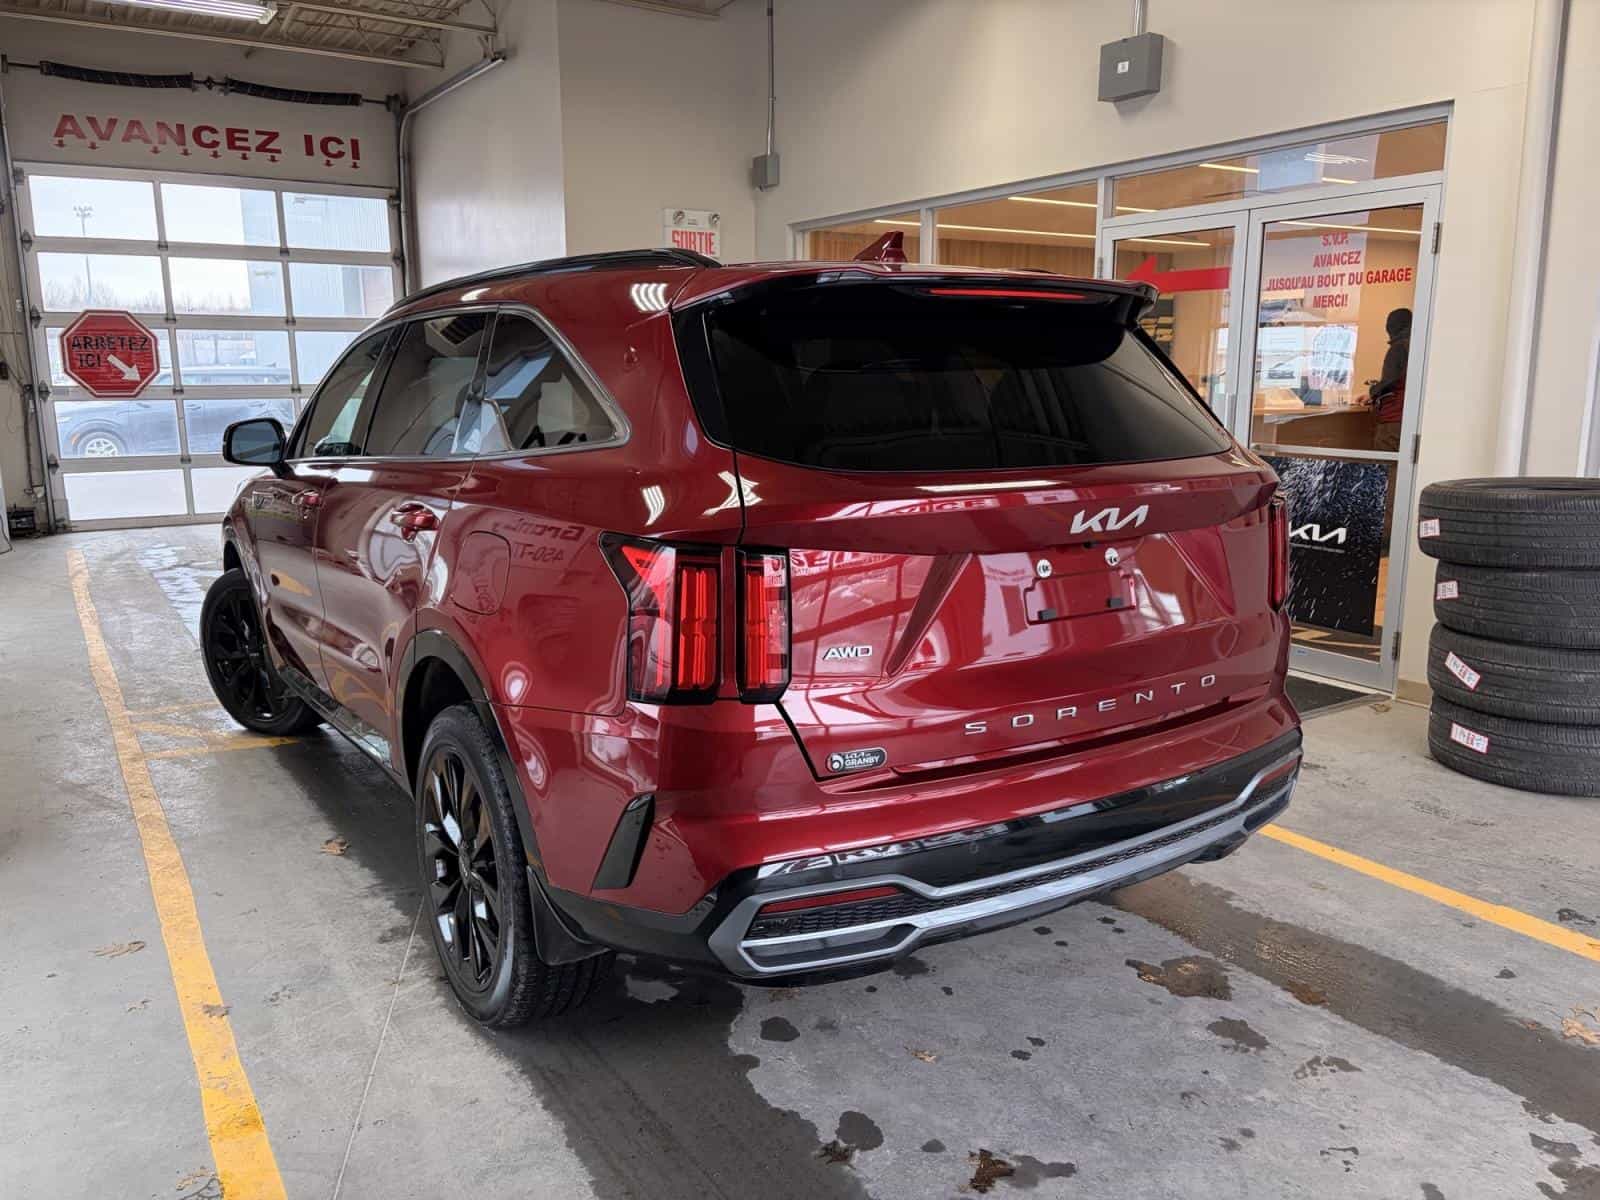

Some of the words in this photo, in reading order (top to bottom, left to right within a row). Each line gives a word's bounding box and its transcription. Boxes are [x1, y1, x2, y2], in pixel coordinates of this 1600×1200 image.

[53, 114, 282, 154] AVANCEZ
[303, 134, 360, 160] ICI
[671, 229, 716, 255] SORTIE
[1321, 233, 1349, 247] S.V.P.
[1313, 251, 1361, 268] AVANCEZ
[1266, 275, 1314, 291] JUSQU'AU
[1317, 273, 1346, 288] BOUT
[1348, 270, 1363, 285] DU
[1365, 268, 1412, 284] GARAGE
[78, 353, 102, 368] ICI
[1070, 504, 1149, 534] KIA
[822, 645, 873, 661] AWD
[964, 673, 1216, 735] SORENTO
[844, 755, 880, 767] GRANBY
